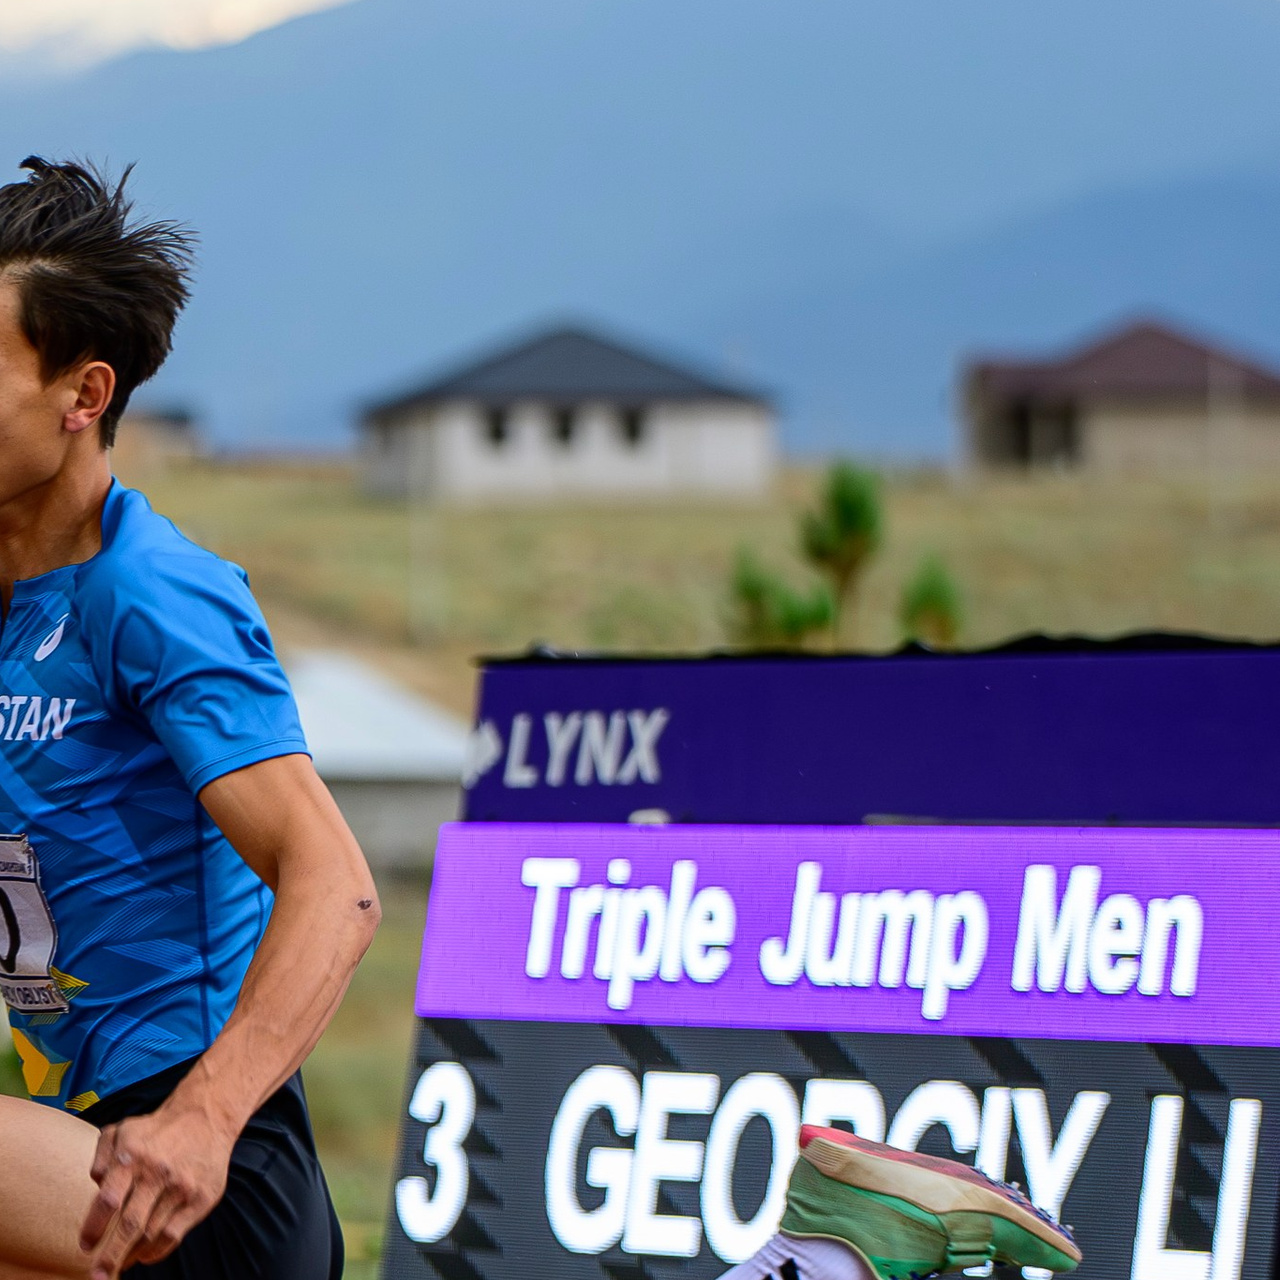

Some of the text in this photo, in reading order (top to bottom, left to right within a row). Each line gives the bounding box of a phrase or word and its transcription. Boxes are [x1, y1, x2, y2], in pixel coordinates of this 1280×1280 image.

[503, 708, 668, 787] LYNX
[521, 856, 1204, 1020] Triple Jump Men
[395, 1061, 476, 1244] 3
